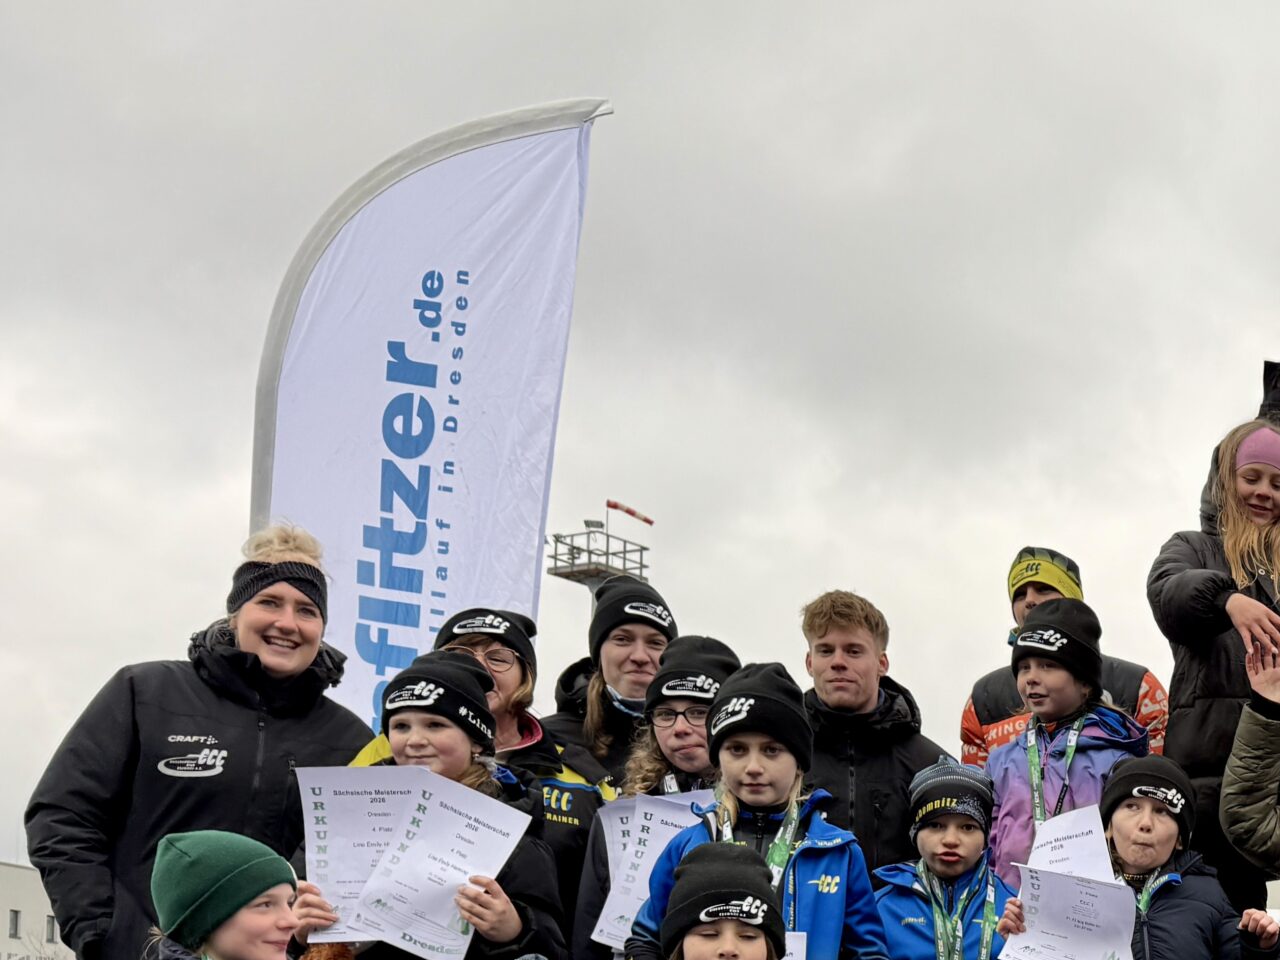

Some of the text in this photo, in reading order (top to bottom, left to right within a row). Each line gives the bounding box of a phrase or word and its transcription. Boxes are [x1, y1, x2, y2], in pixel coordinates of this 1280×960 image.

[443, 269, 470, 433] Dresden
[437, 460, 455, 493] in
[355, 270, 445, 735] flitzer.de
[168, 735, 207, 743] CRAFT
[987, 719, 1026, 741] KING
[545, 812, 580, 826] RAINER
